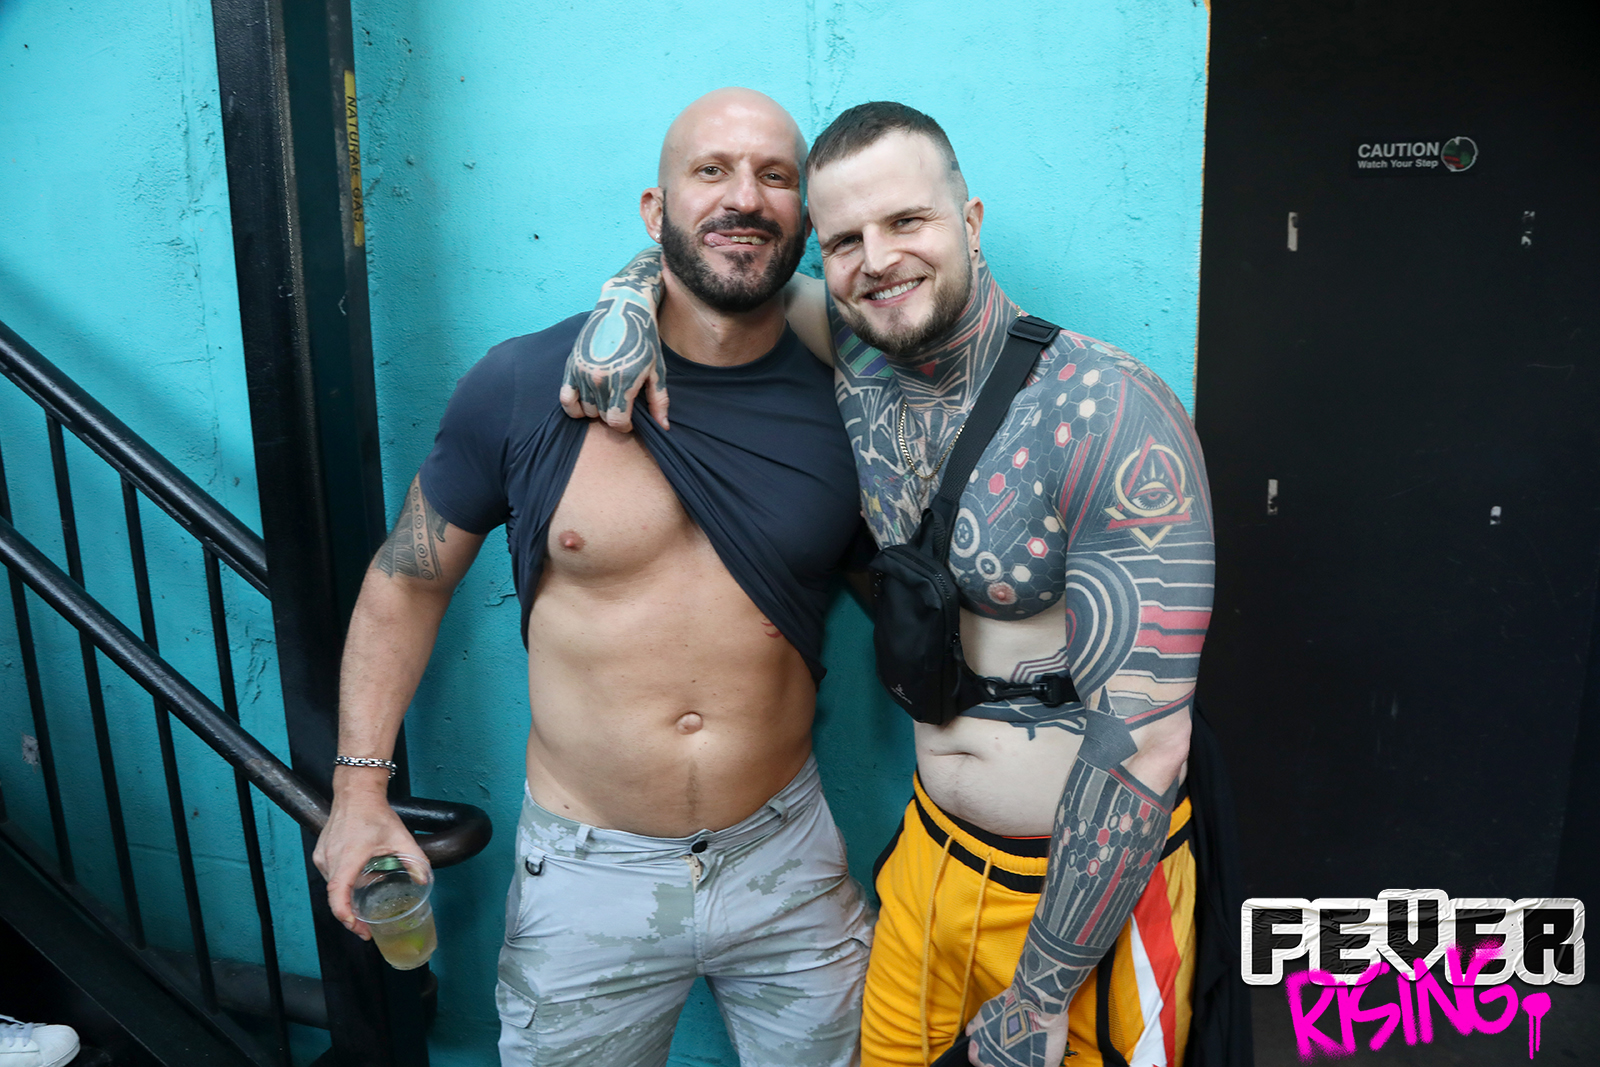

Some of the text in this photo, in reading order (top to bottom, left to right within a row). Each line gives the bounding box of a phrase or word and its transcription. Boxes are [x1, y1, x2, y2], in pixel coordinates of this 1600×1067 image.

[1358, 142, 1440, 158] CAUTION
[346, 95, 364, 222] NATURAL GAS
[1357, 159, 1439, 169] Watch Your Step
